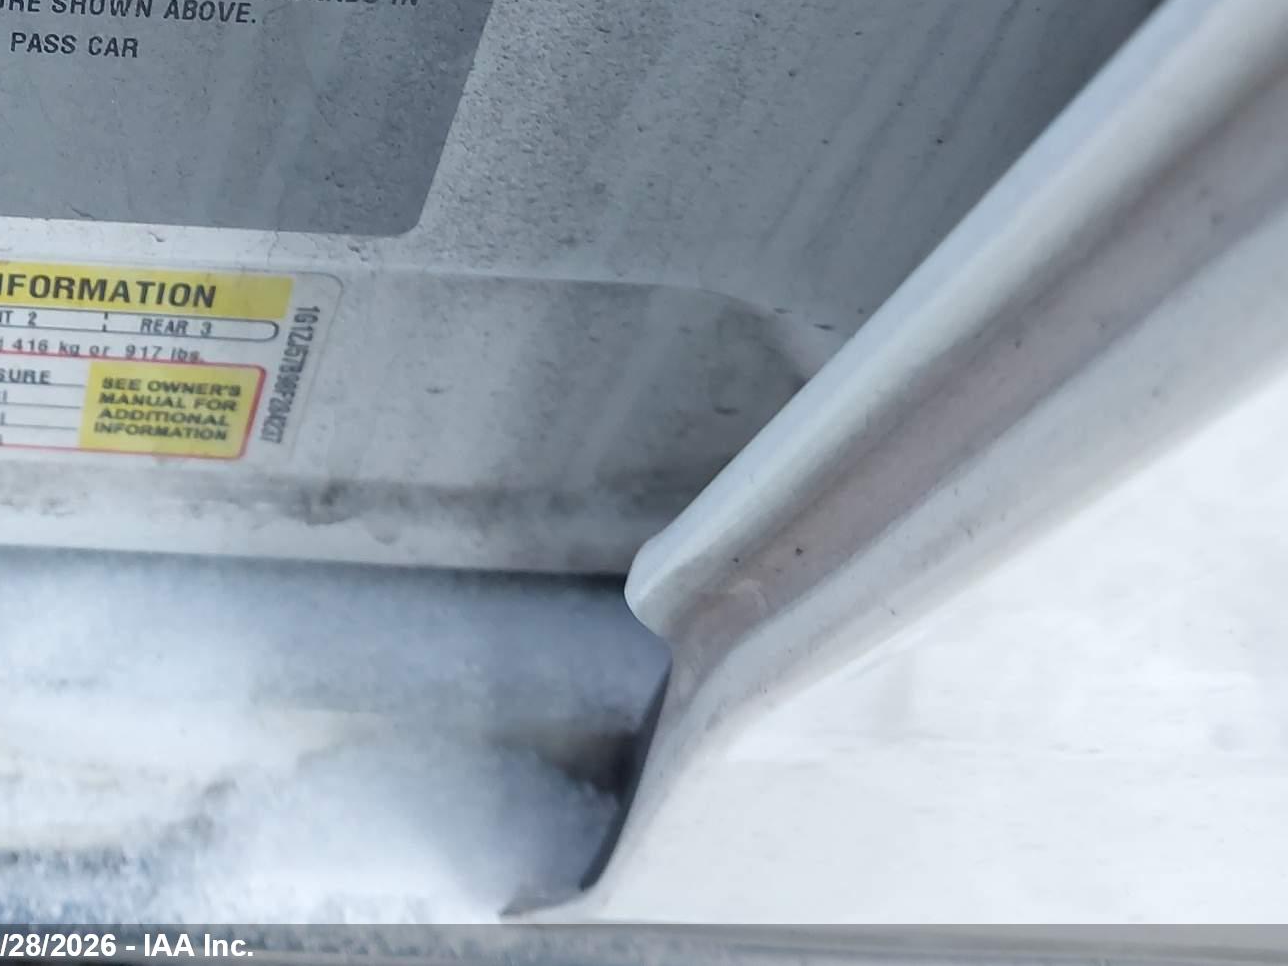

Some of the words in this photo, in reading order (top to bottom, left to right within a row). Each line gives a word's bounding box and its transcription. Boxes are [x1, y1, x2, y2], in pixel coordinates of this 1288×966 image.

[162, 0, 257, 26] ABOVE.
[10, 32, 77, 57] PASS
[87, 36, 139, 60] CAR
[27, 310, 37, 326] 2
[140, 317, 191, 335] REAR
[200, 320, 212, 336] 3
[12, 338, 49, 355] 416
[58, 340, 80, 357] kg
[89, 343, 110, 356] or
[125, 343, 164, 360] 917
[101, 376, 141, 391] SEE
[148, 379, 241, 397] OWNER'S
[98, 392, 184, 410] MANUAL
[193, 396, 236, 412] FOR
[98, 408, 229, 427] ADDITIONAL
[94, 421, 227, 441] INFORMATION
